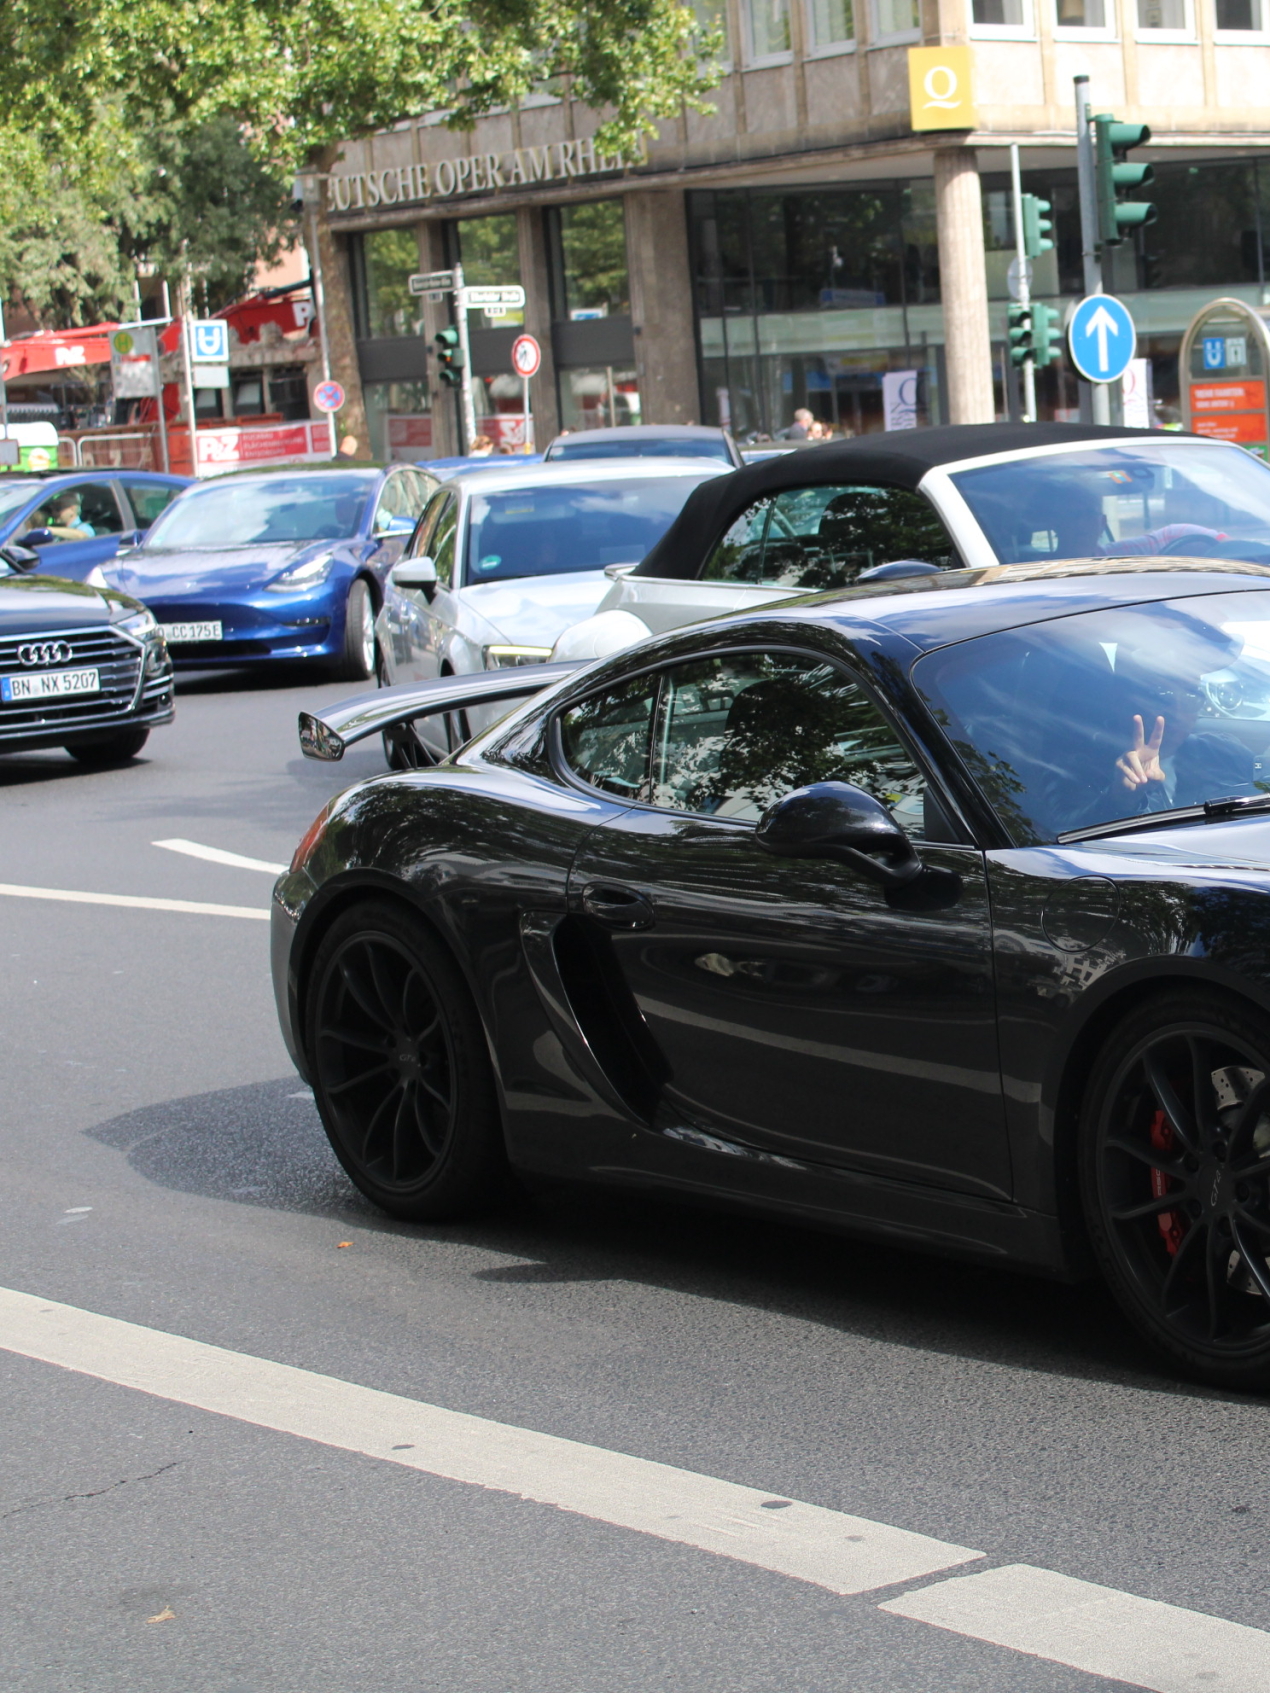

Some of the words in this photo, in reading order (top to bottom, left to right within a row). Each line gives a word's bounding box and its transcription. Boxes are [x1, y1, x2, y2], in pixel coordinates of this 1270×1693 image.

[922, 65, 962, 110] Q
[327, 163, 428, 212] EUTSCHE
[434, 153, 503, 197] OPER
[508, 144, 554, 186] AM
[558, 131, 645, 179] RHEI
[12, 678, 31, 697] BN
[41, 675, 60, 692] NX
[63, 671, 97, 691] 5207
